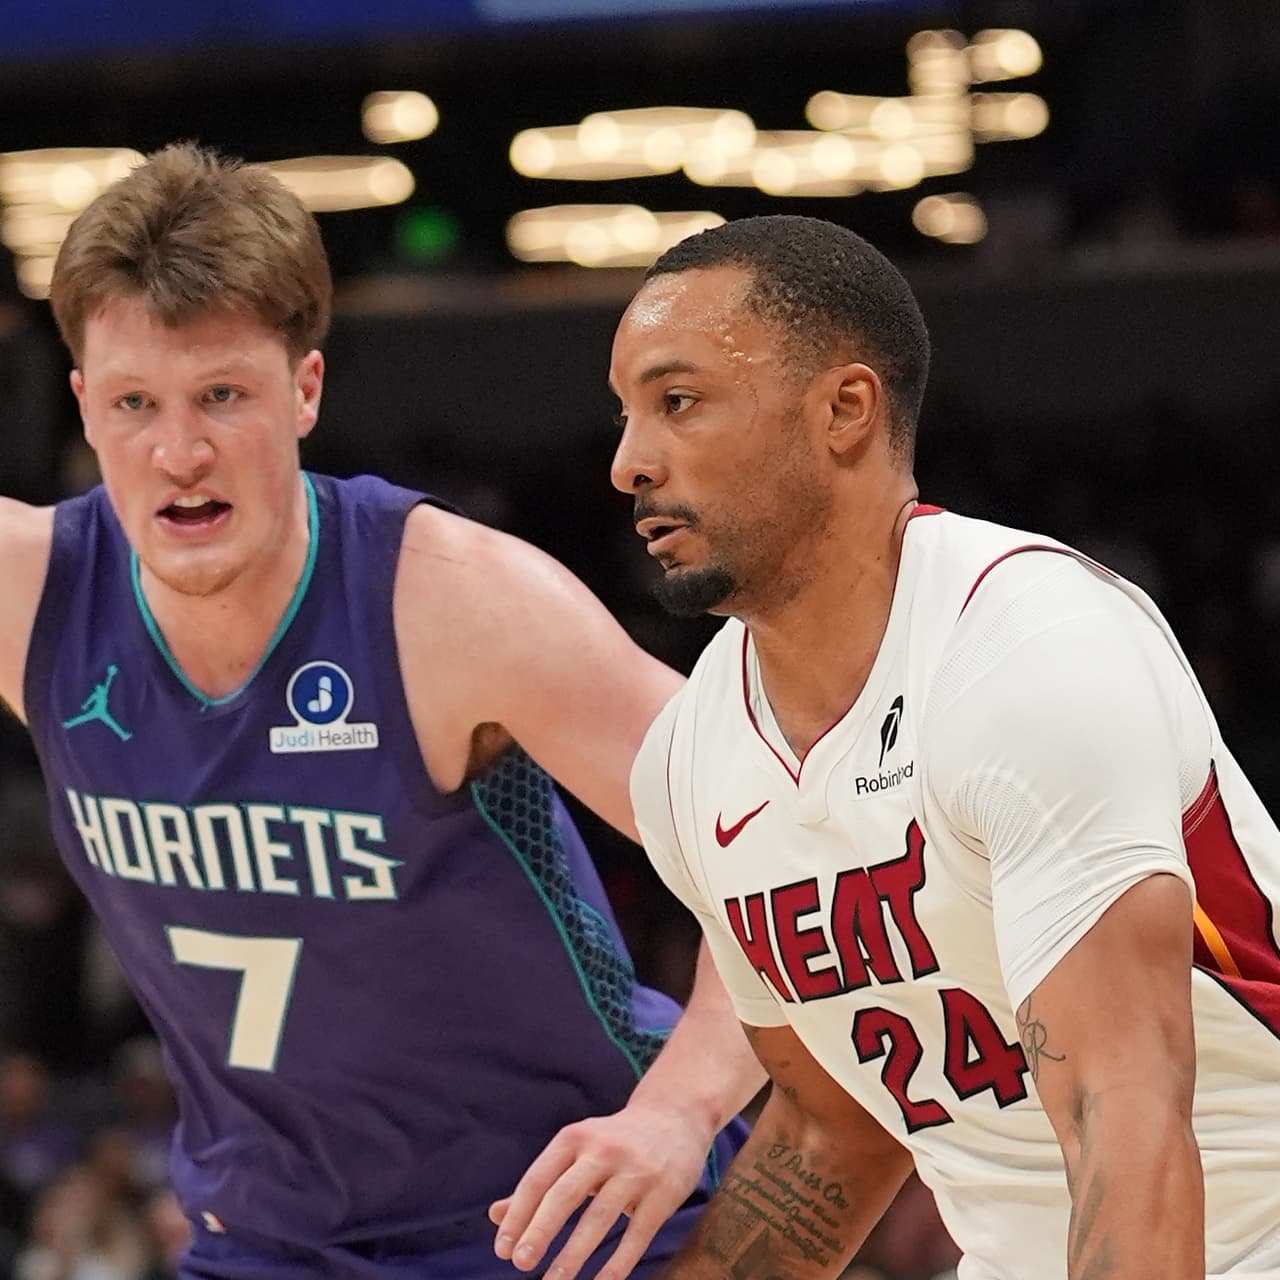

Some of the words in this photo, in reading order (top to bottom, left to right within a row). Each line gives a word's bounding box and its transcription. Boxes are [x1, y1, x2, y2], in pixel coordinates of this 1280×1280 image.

[275, 728, 315, 748] Judi
[319, 726, 375, 746] Health
[65, 788, 405, 900] HORNETS
[724, 817, 940, 1004] HEAT
[163, 924, 304, 1074] 7
[851, 987, 1031, 1135] 24
